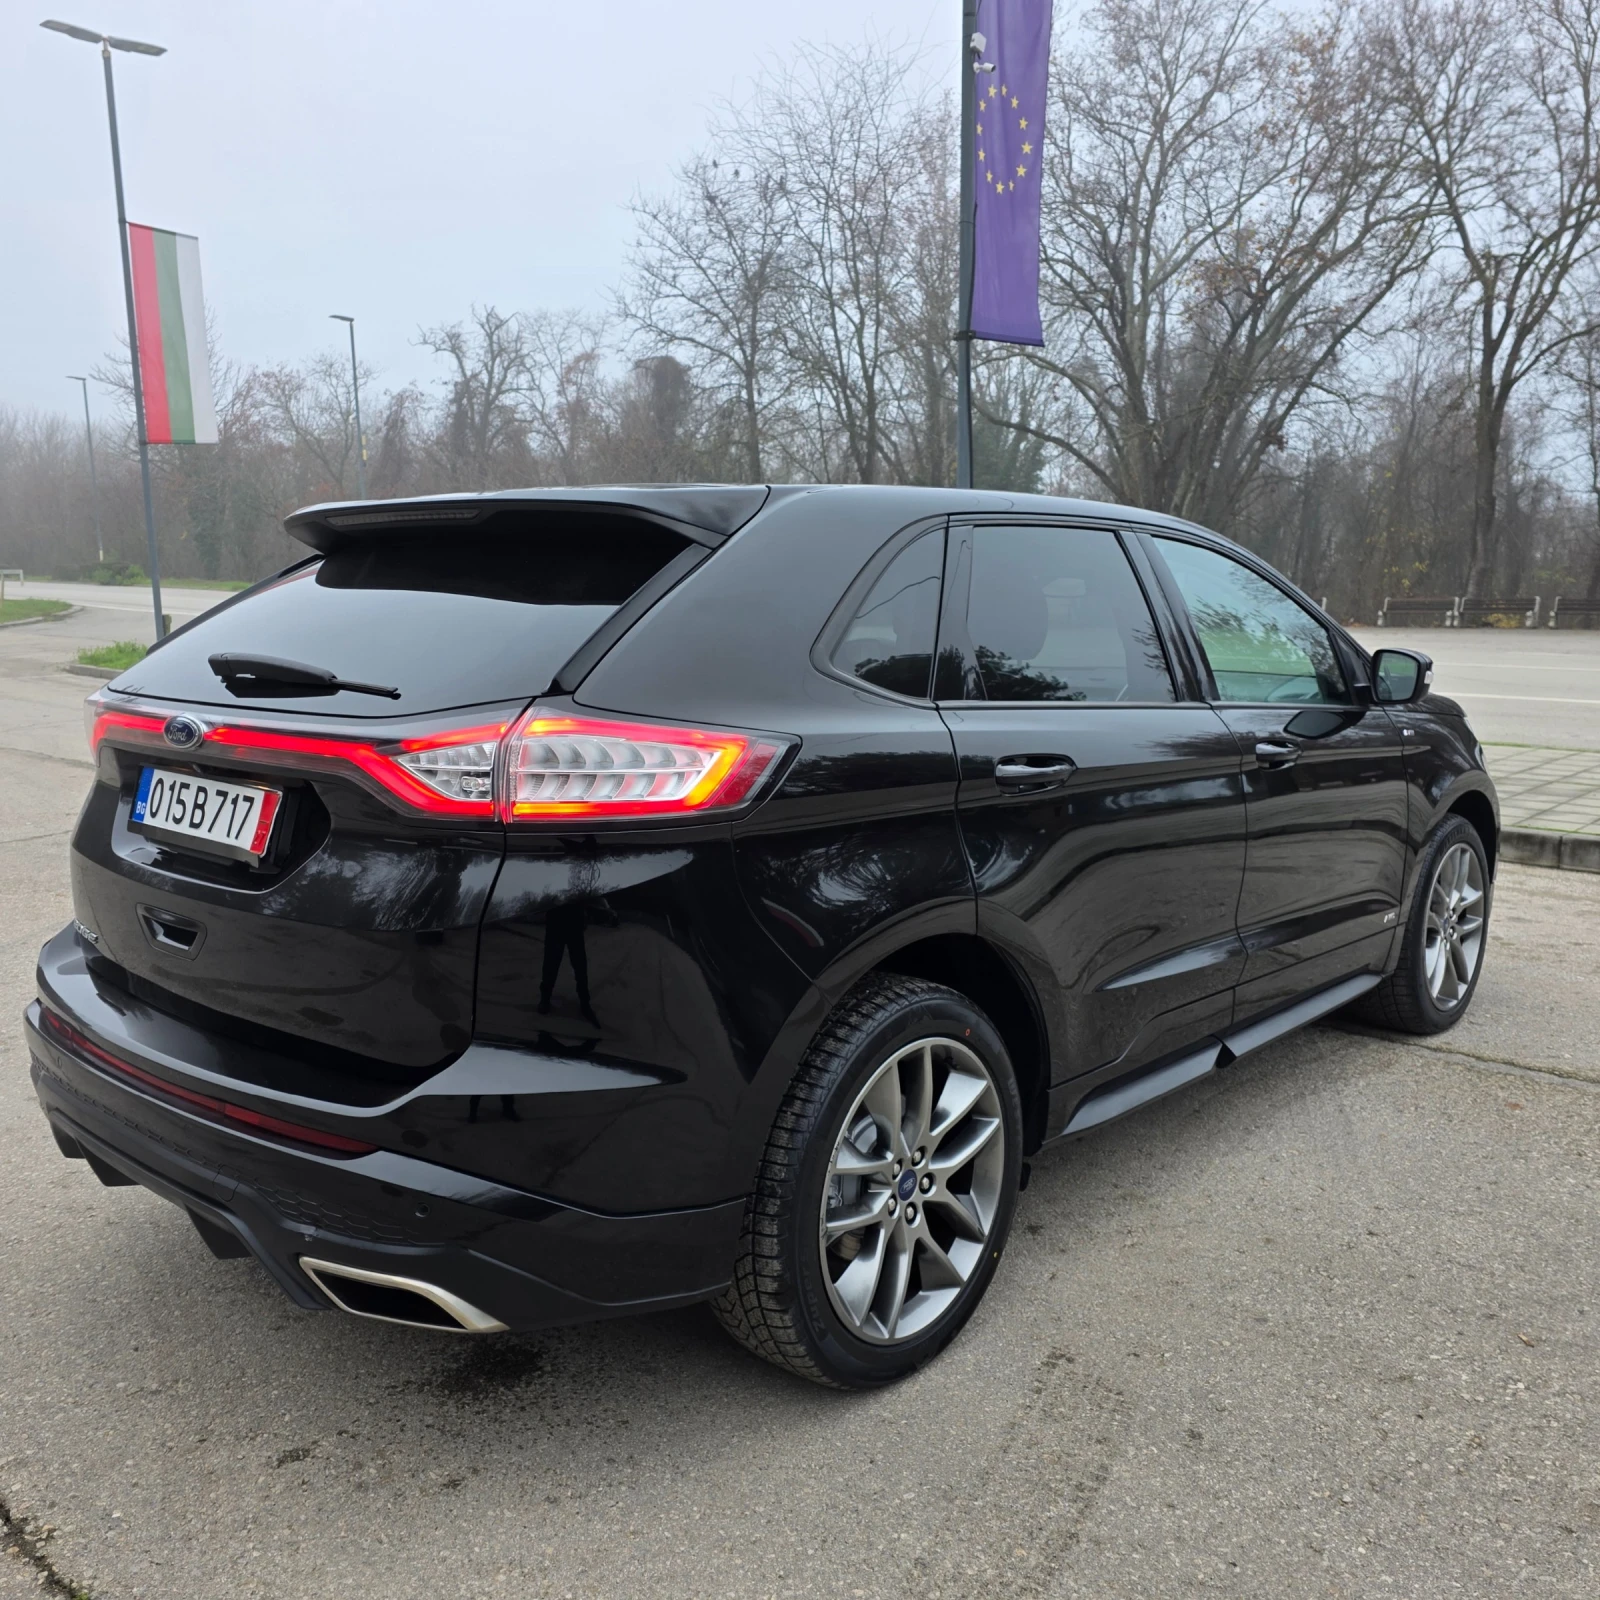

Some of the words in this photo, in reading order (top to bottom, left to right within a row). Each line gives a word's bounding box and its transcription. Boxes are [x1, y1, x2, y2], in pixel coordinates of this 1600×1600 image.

[168, 723, 188, 741] Ford
[136, 801, 146, 815] BG
[149, 777, 255, 840] 015B717
